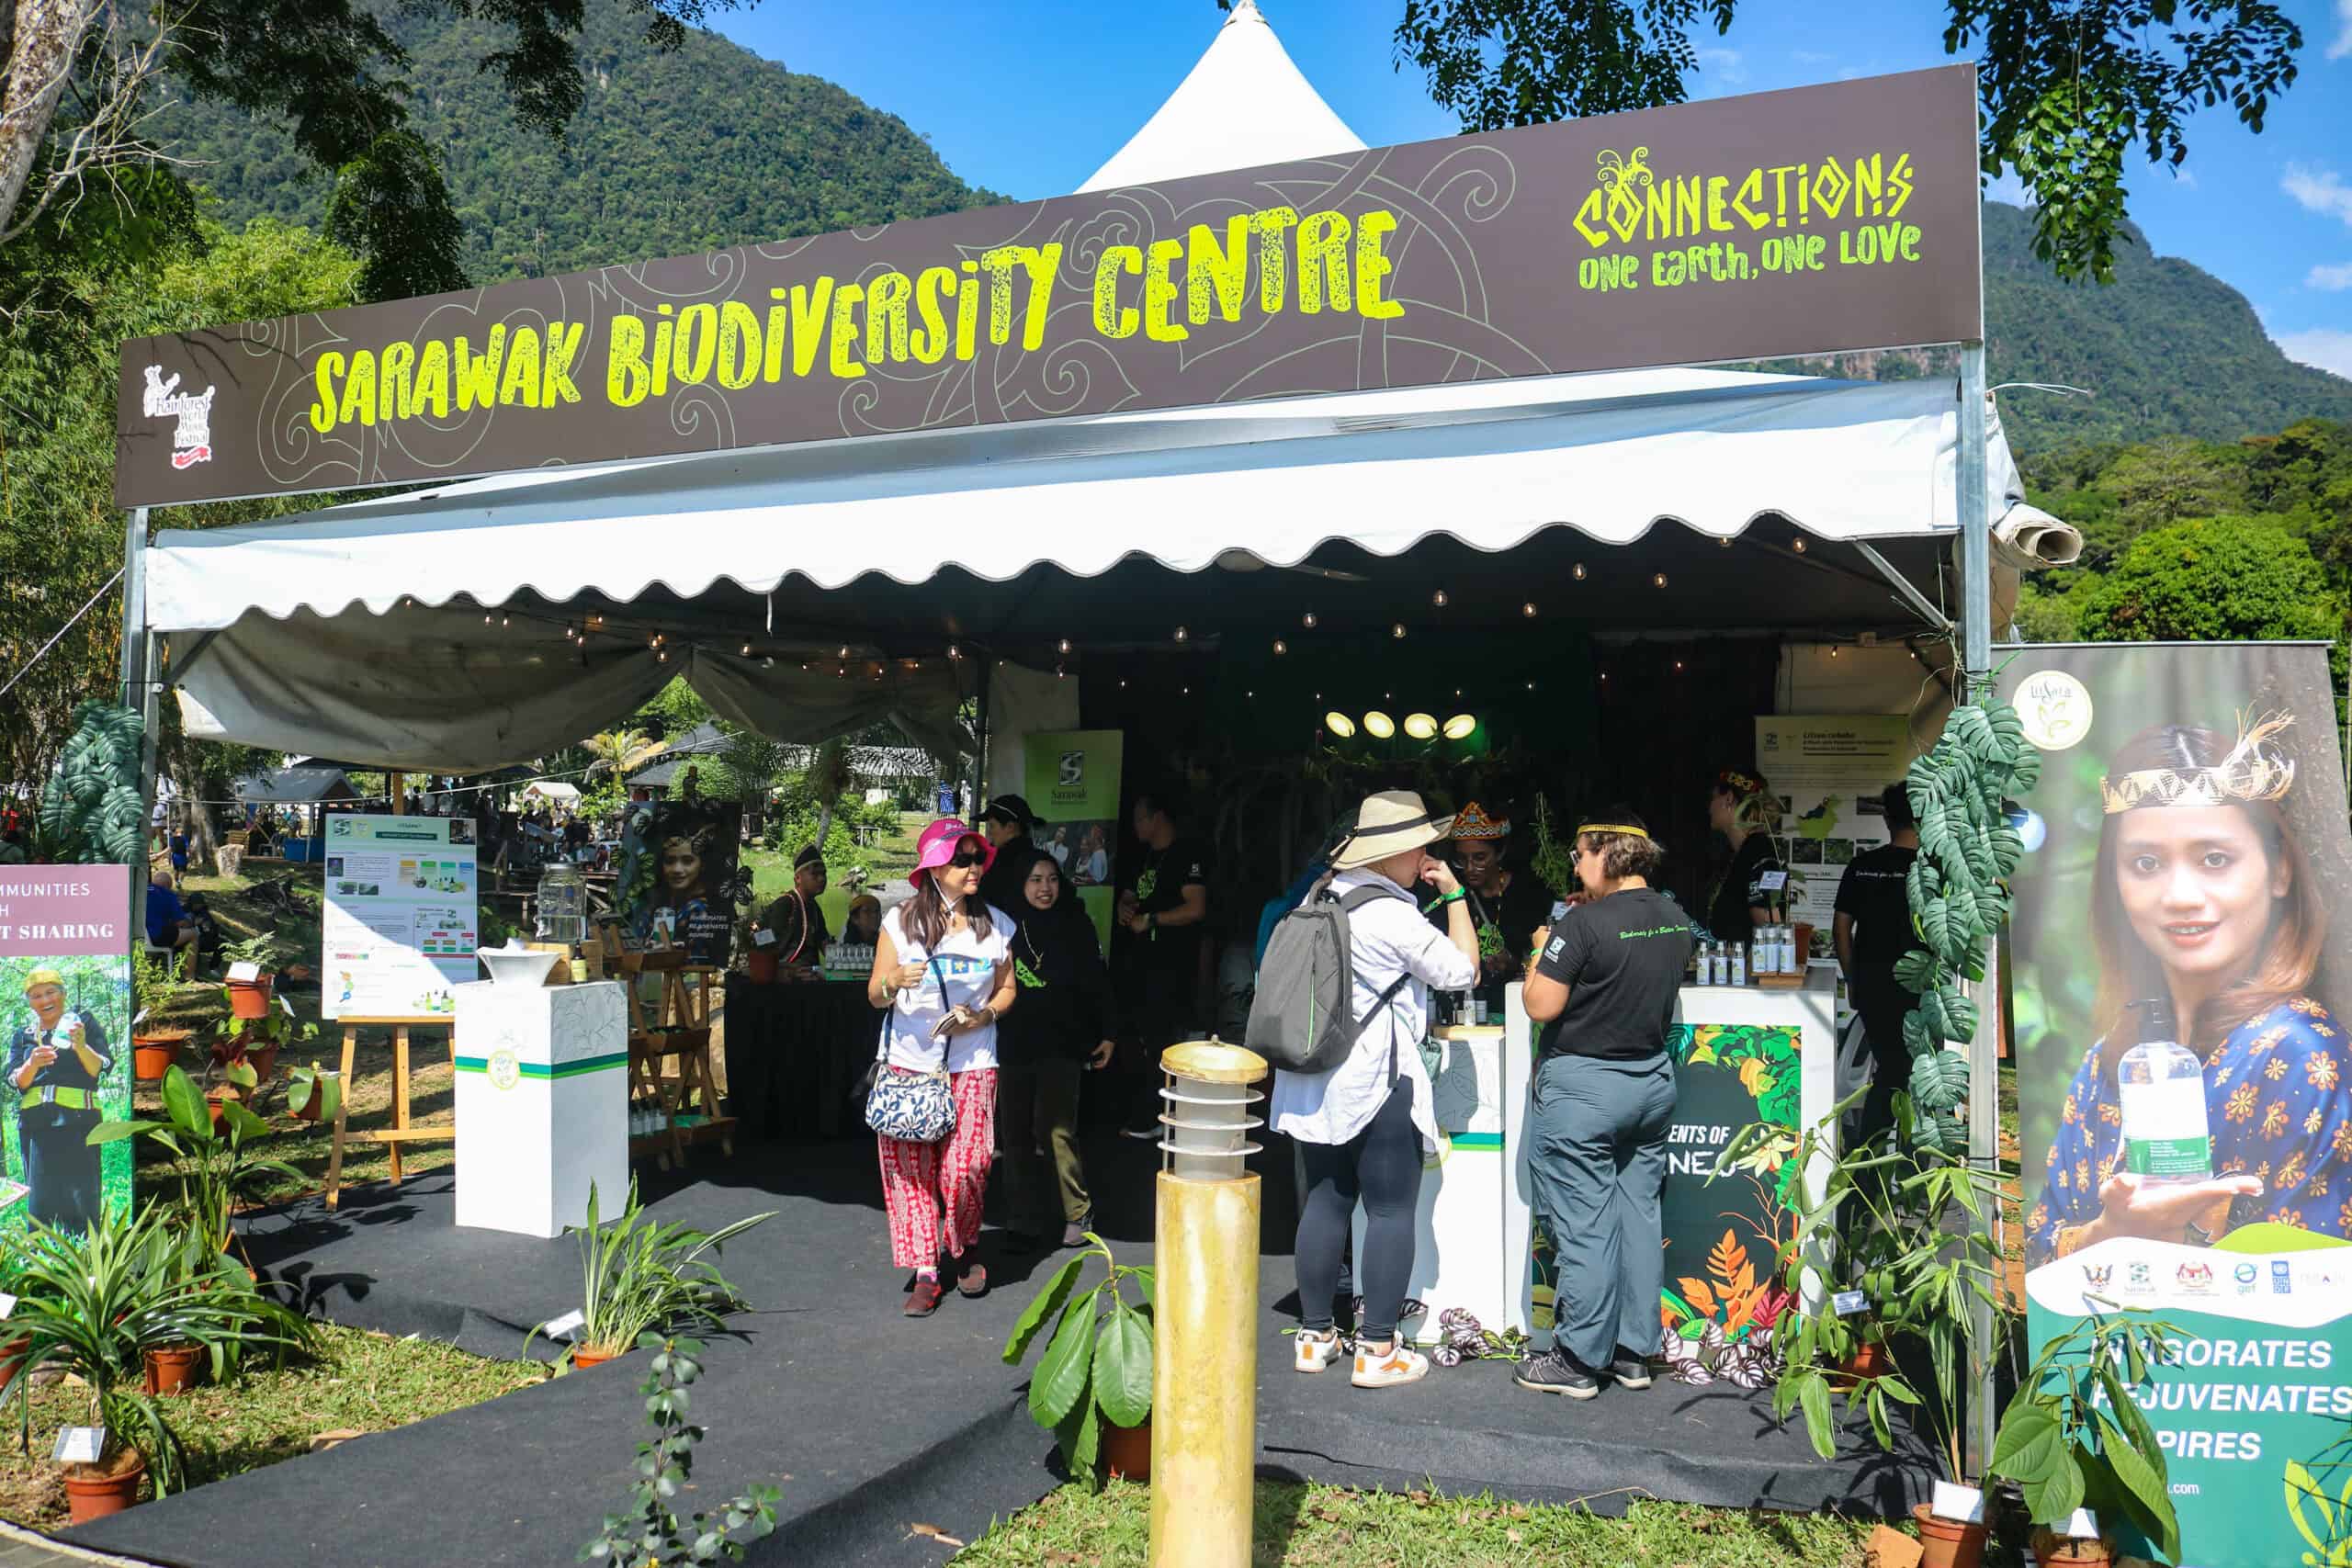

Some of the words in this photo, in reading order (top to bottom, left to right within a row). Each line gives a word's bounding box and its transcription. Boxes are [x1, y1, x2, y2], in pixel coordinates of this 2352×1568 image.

[311, 321, 584, 434] SARAWAK
[1092, 206, 1405, 342] CENTRE
[18, 922, 115, 941] SHARING
[1709, 1125, 1731, 1145] OF
